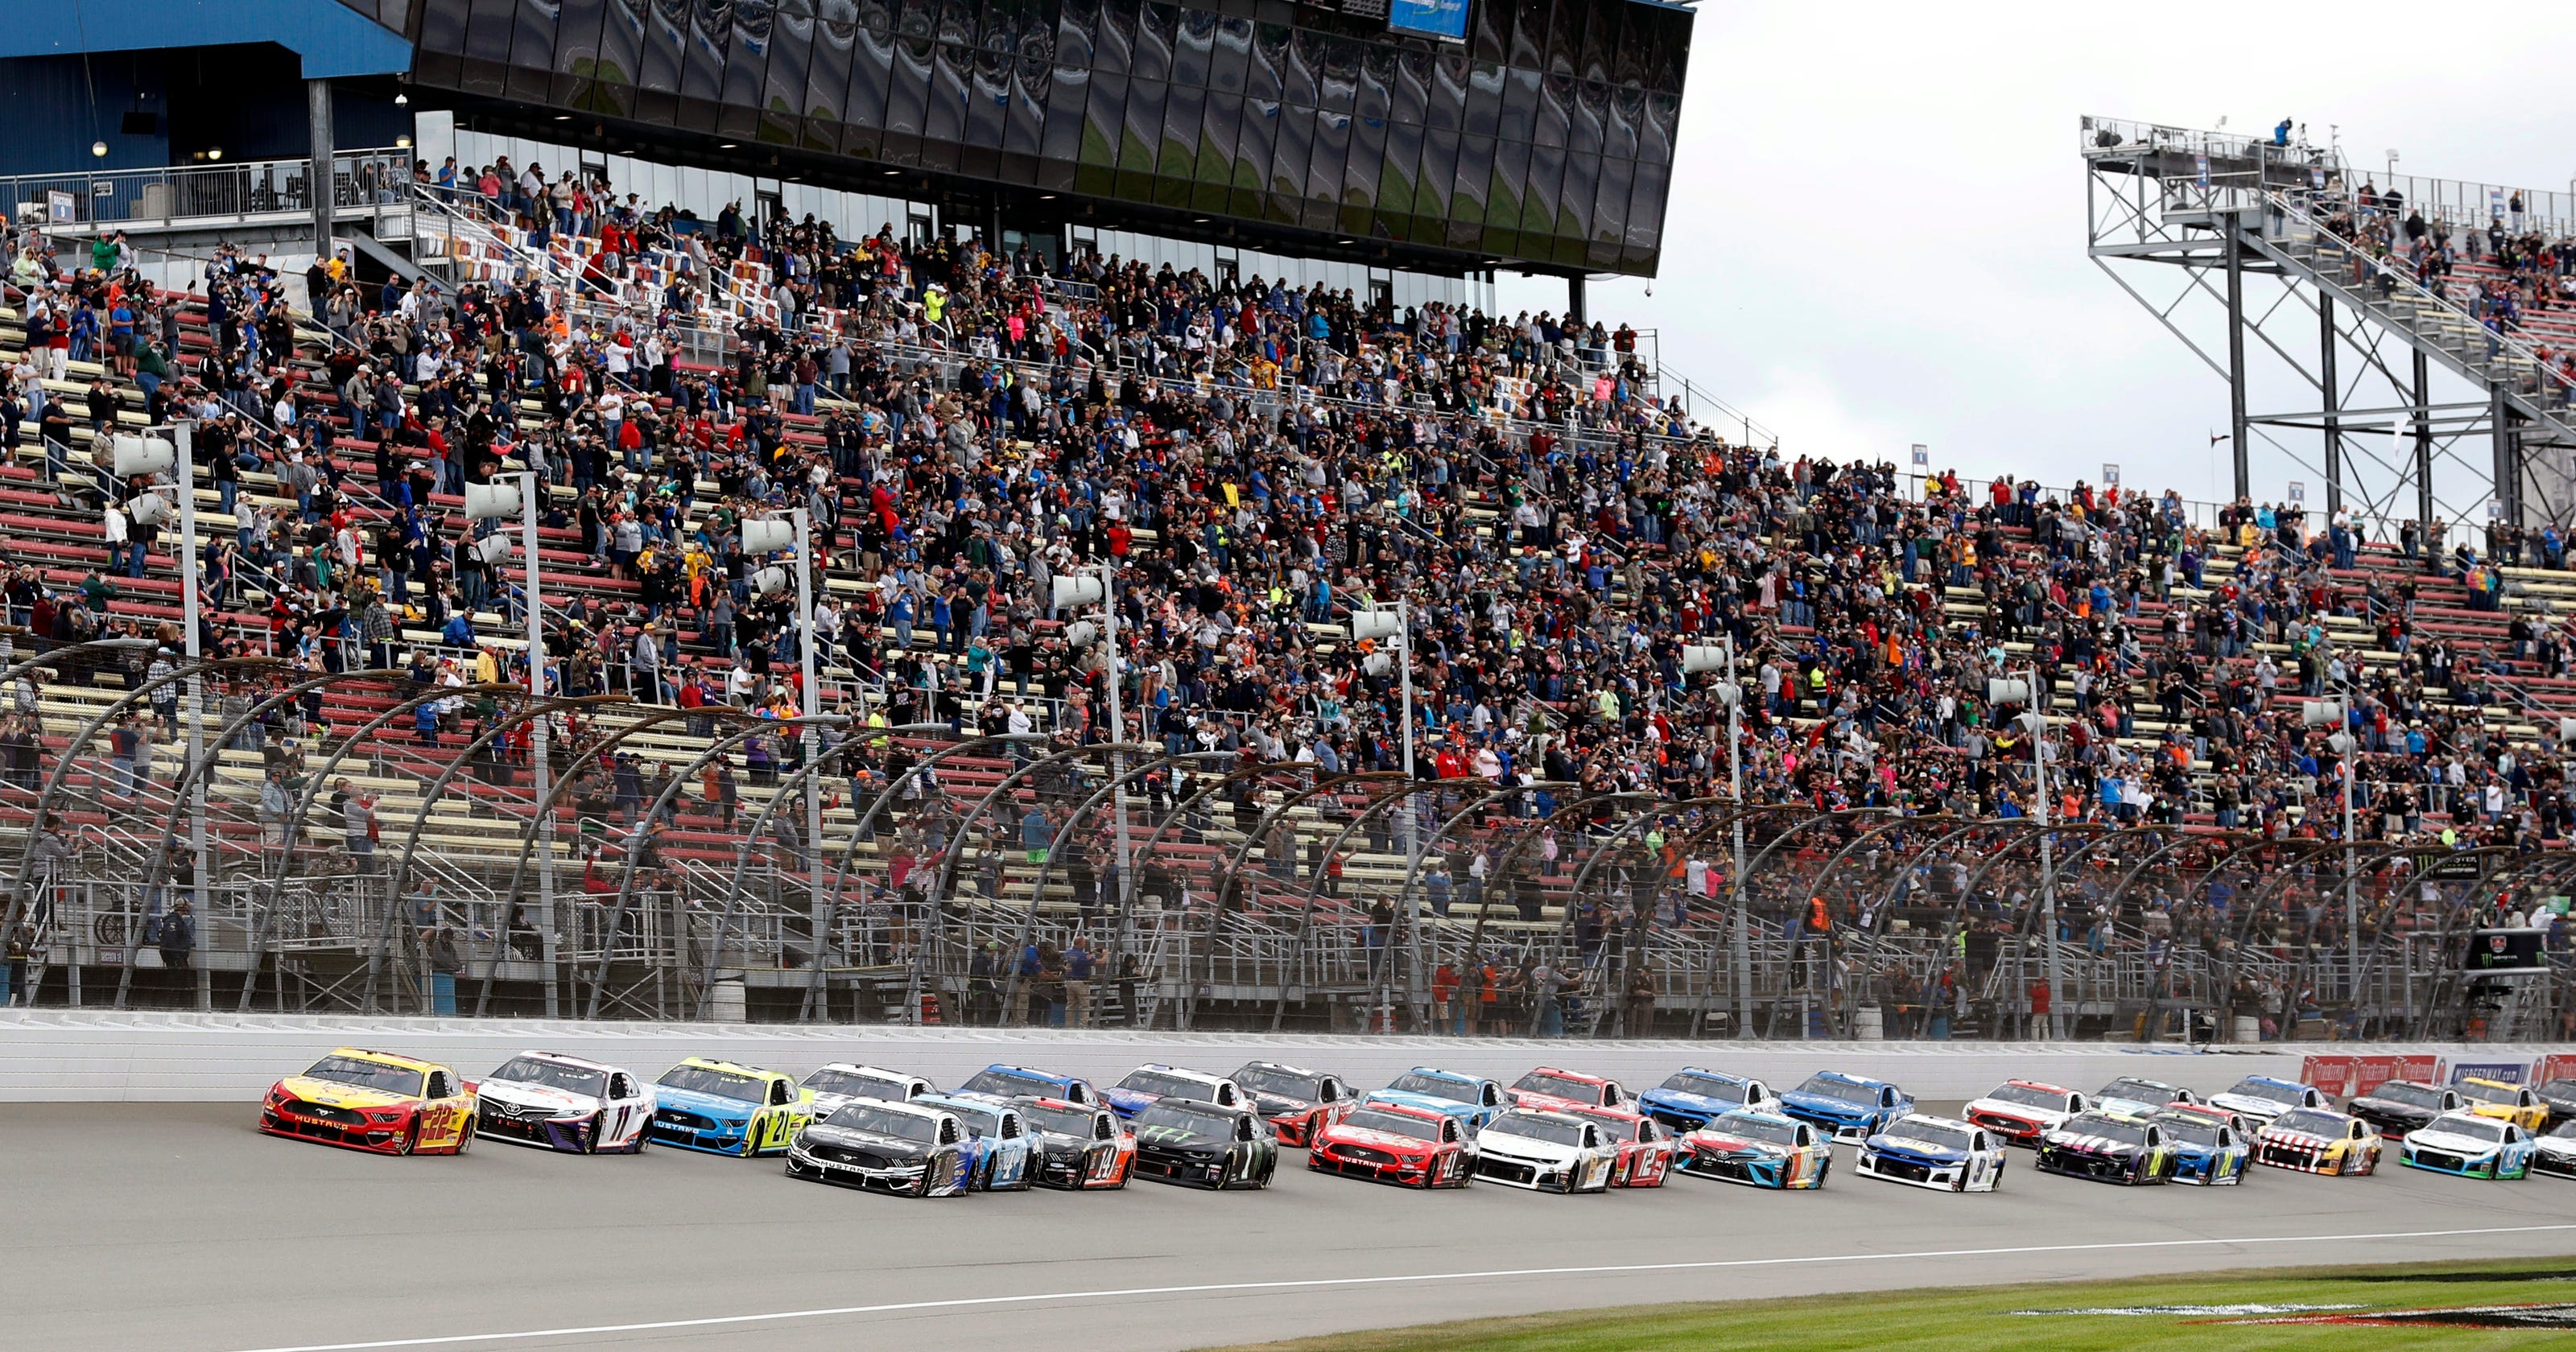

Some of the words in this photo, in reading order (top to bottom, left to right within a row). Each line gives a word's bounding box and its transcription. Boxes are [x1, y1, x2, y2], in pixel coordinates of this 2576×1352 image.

[425, 1103, 452, 1140] 22
[609, 1104, 632, 1141] 11
[772, 1110, 790, 1142] 21
[1983, 1123, 2021, 1135] MUSTANG
[820, 1160, 871, 1174] MUSTANG
[1001, 1145, 1018, 1180] 4
[1095, 1147, 1115, 1179] 14
[1338, 1155, 1383, 1169] MUSTANG
[1443, 1149, 1459, 1178] 41
[1637, 1148, 1657, 1177] 12
[1798, 1152, 1812, 1179] 18
[1972, 1156, 1988, 1183] 9
